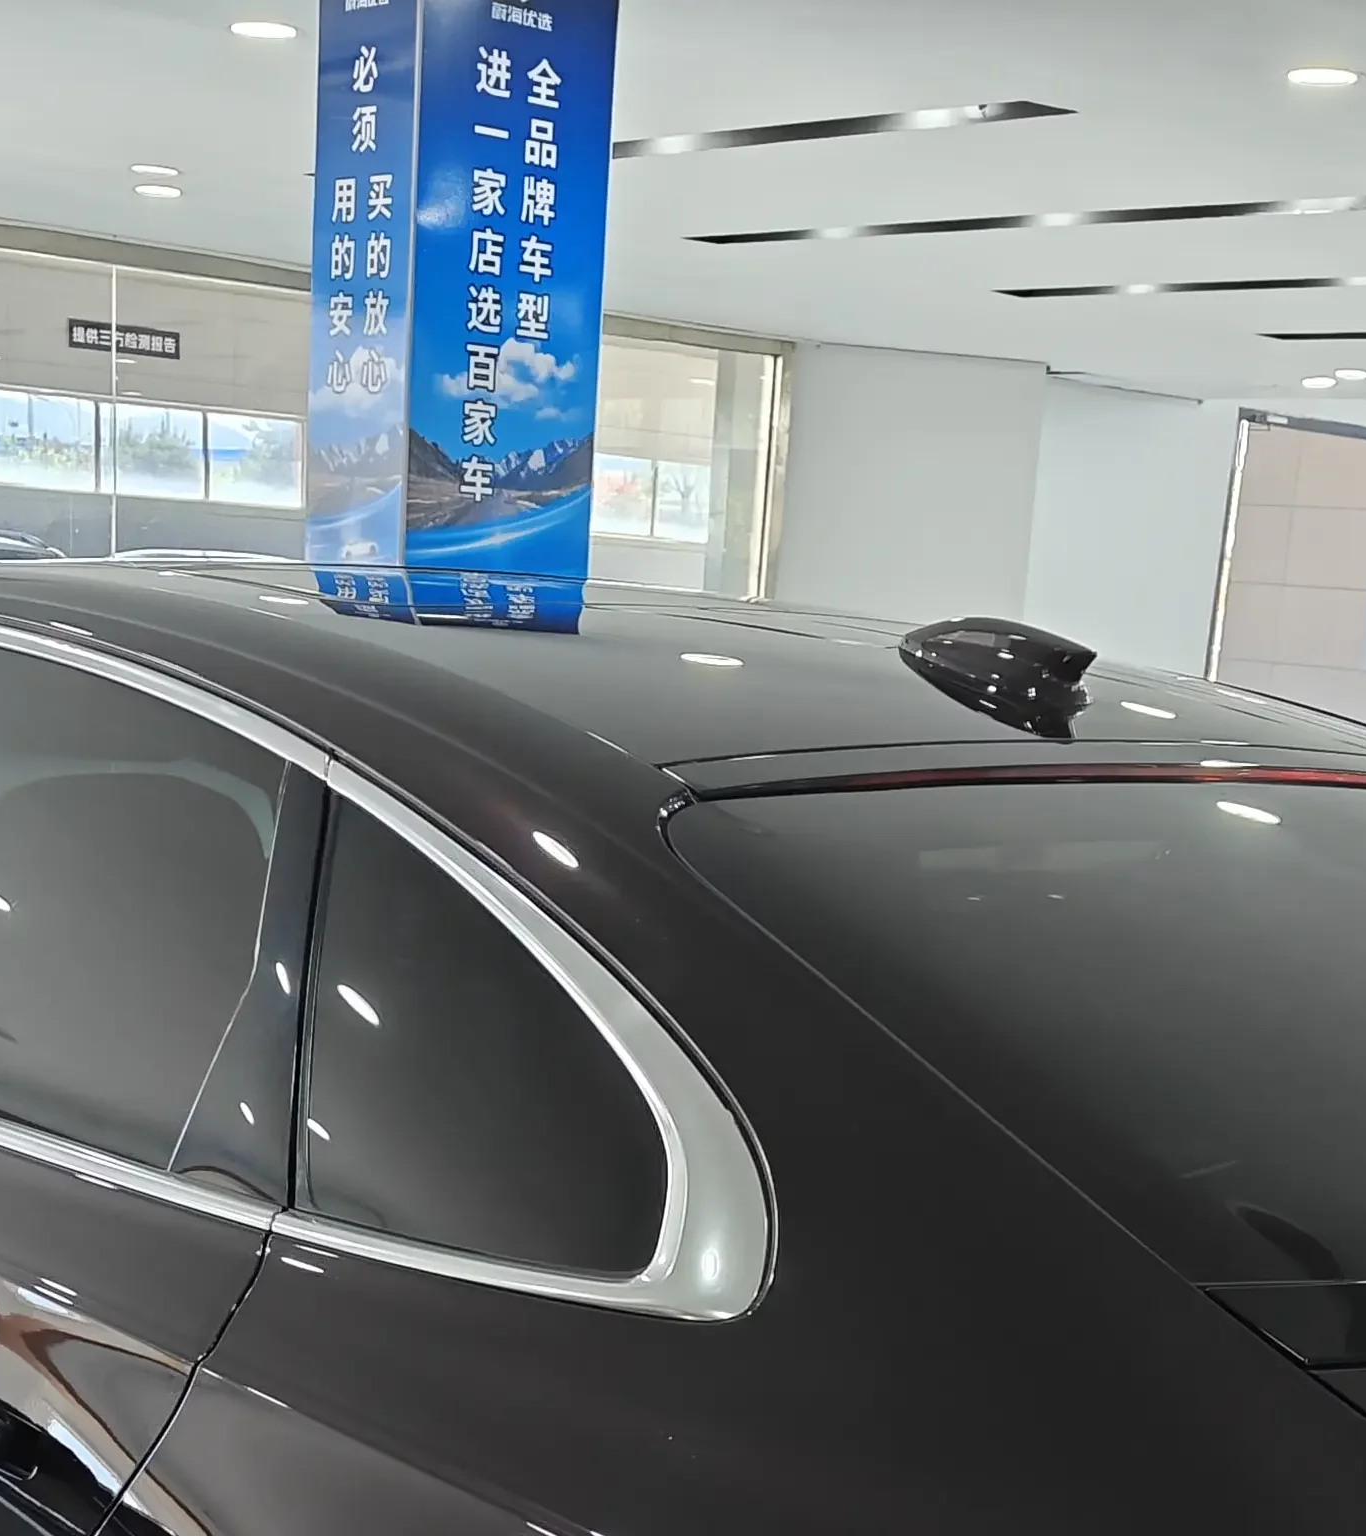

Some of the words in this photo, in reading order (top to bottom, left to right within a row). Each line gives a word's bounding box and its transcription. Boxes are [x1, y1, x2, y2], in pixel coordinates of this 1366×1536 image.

[351, 45, 379, 153] 必须
[491, 2, 553, 32] 蔚海优选
[327, 178, 356, 393] 用的安心
[360, 174, 393, 394] 买的放心
[459, 46, 512, 502] 进一家店选百家车
[516, 58, 562, 340] 全品牌车型
[72, 326, 176, 354] 提供三方检测报告
